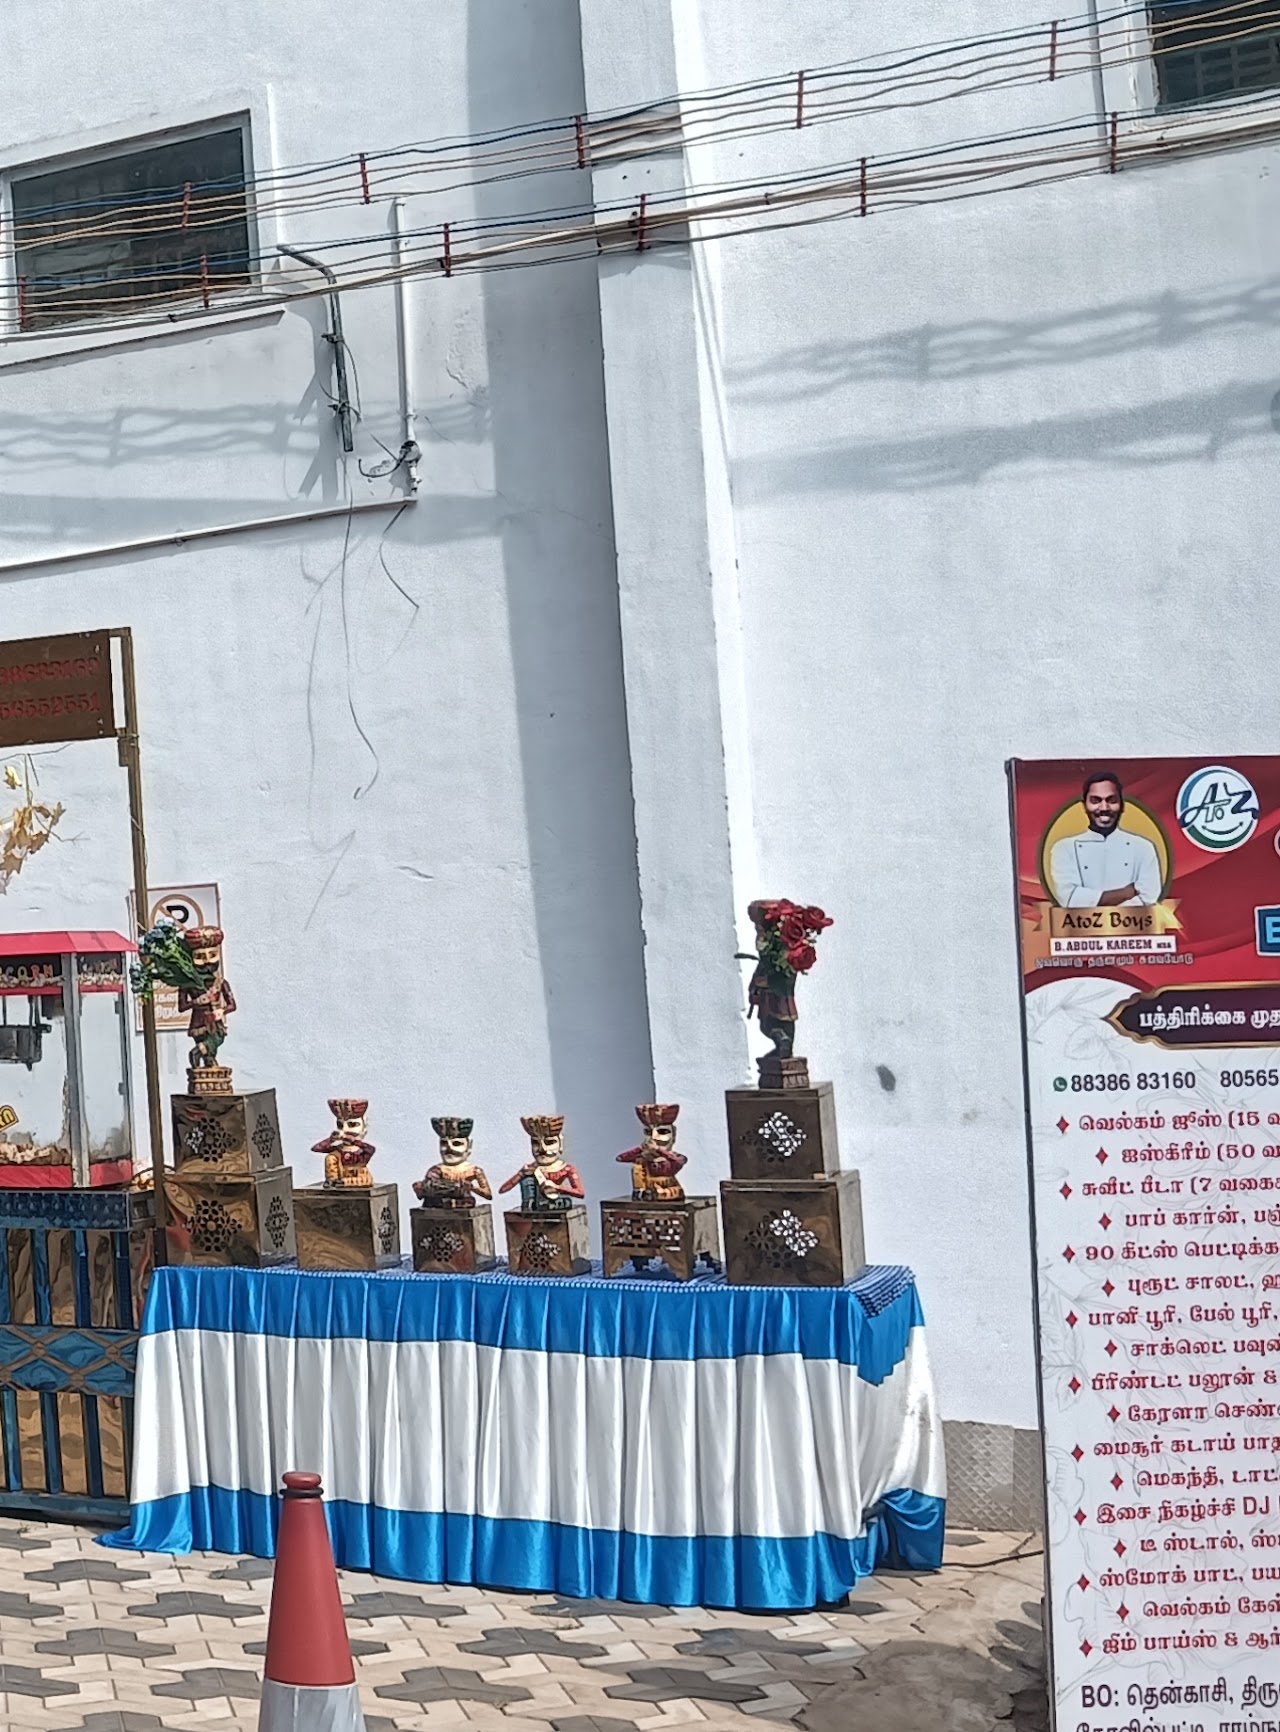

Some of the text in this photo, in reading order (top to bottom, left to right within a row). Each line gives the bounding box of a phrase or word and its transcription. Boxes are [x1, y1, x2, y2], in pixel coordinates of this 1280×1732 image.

[1109, 911, 1153, 931] Boys
[1106, 938, 1153, 950] KAREEM
[1139, 1003, 1246, 1031] பத்திரிக்கை
[1070, 1068, 1280, 1093] 88386 83160 80565
[1078, 1110, 1166, 1131] வெல்கம்
[1171, 1108, 1222, 1130] ஜூஸ்
[1228, 1109, 1261, 1129] (15
[1121, 1141, 1211, 1164] ஐஸ்கிரீம்
[1217, 1143, 1256, 1162] (50
[1190, 1176, 1212, 1195] (7
[1125, 1207, 1167, 1227] பாப்
[1172, 1203, 1247, 1226] கார்ன்,
[1085, 1244, 1115, 1260] 90
[1121, 1239, 1178, 1260] கிட்ஸ்
[1088, 1305, 1139, 1326] பானி
[1189, 1302, 1235, 1322] பேல்
[1130, 1336, 1226, 1356] சாக்லெட்
[1091, 1365, 1277, 1393] பிரிண்டட் பலூன் &
[1127, 1398, 1280, 1426] கேரளா செண்
[1093, 1434, 1164, 1457] மைசூர்
[1170, 1432, 1236, 1453] கடாய்
[1231, 1468, 1280, 1484] டாட்
[1096, 1502, 1151, 1524] இசை
[1158, 1498, 1236, 1523] நிகழ்ச்சி
[1242, 1496, 1270, 1515] DJ
[1251, 1529, 1280, 1548] ஸ்
[1099, 1565, 1187, 1588] ஸ்மோக்
[1143, 1596, 1231, 1617] வெல்கம்
[1102, 1631, 1137, 1655] ஜிம்
[1144, 1629, 1217, 1650] பாய்ஸ்
[1223, 1631, 1239, 1648] &
[1081, 1675, 1280, 1714] BO: தென்காசி, திரு
